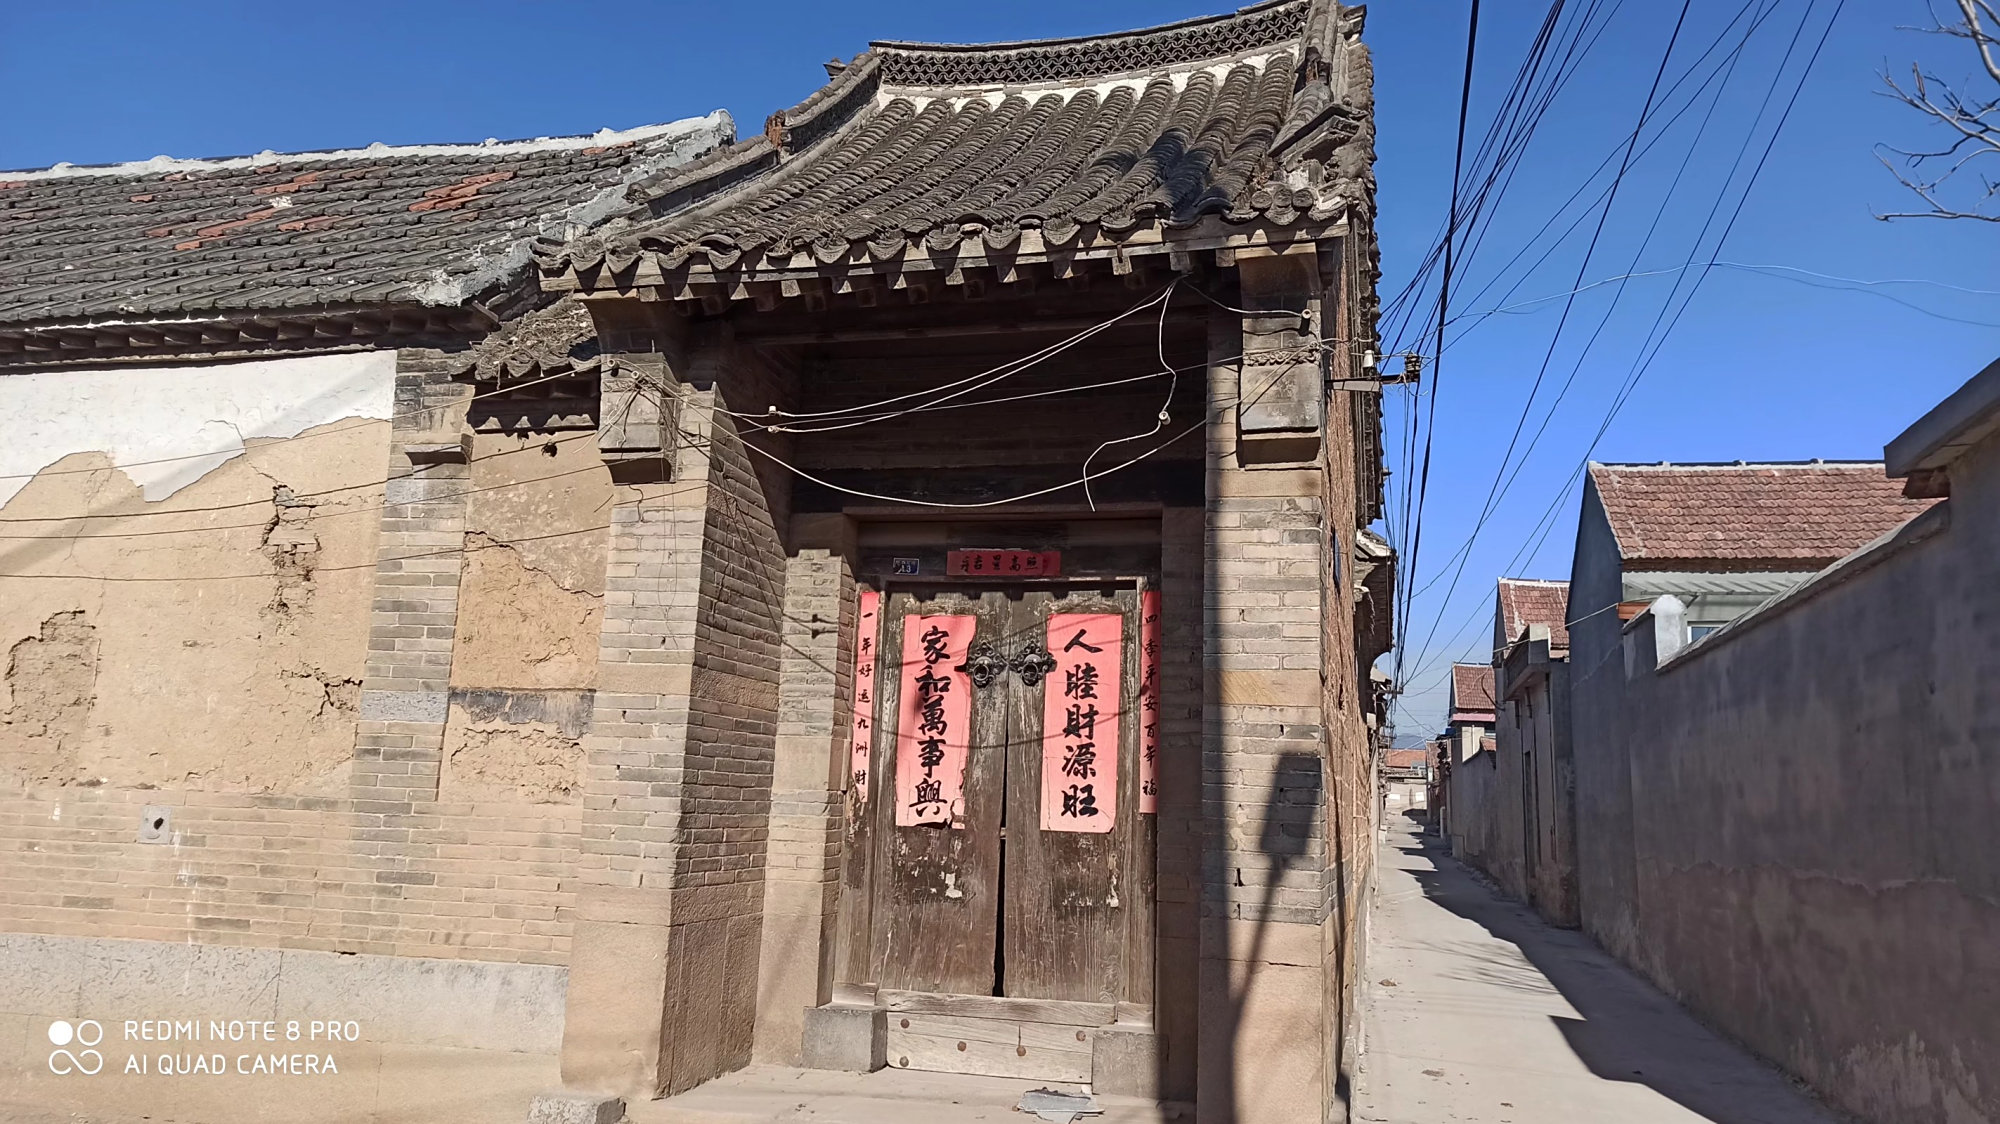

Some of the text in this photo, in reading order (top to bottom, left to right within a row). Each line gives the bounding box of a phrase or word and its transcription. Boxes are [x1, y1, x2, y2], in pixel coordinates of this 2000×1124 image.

[1142, 613, 1159, 798] 四季平安百年福
